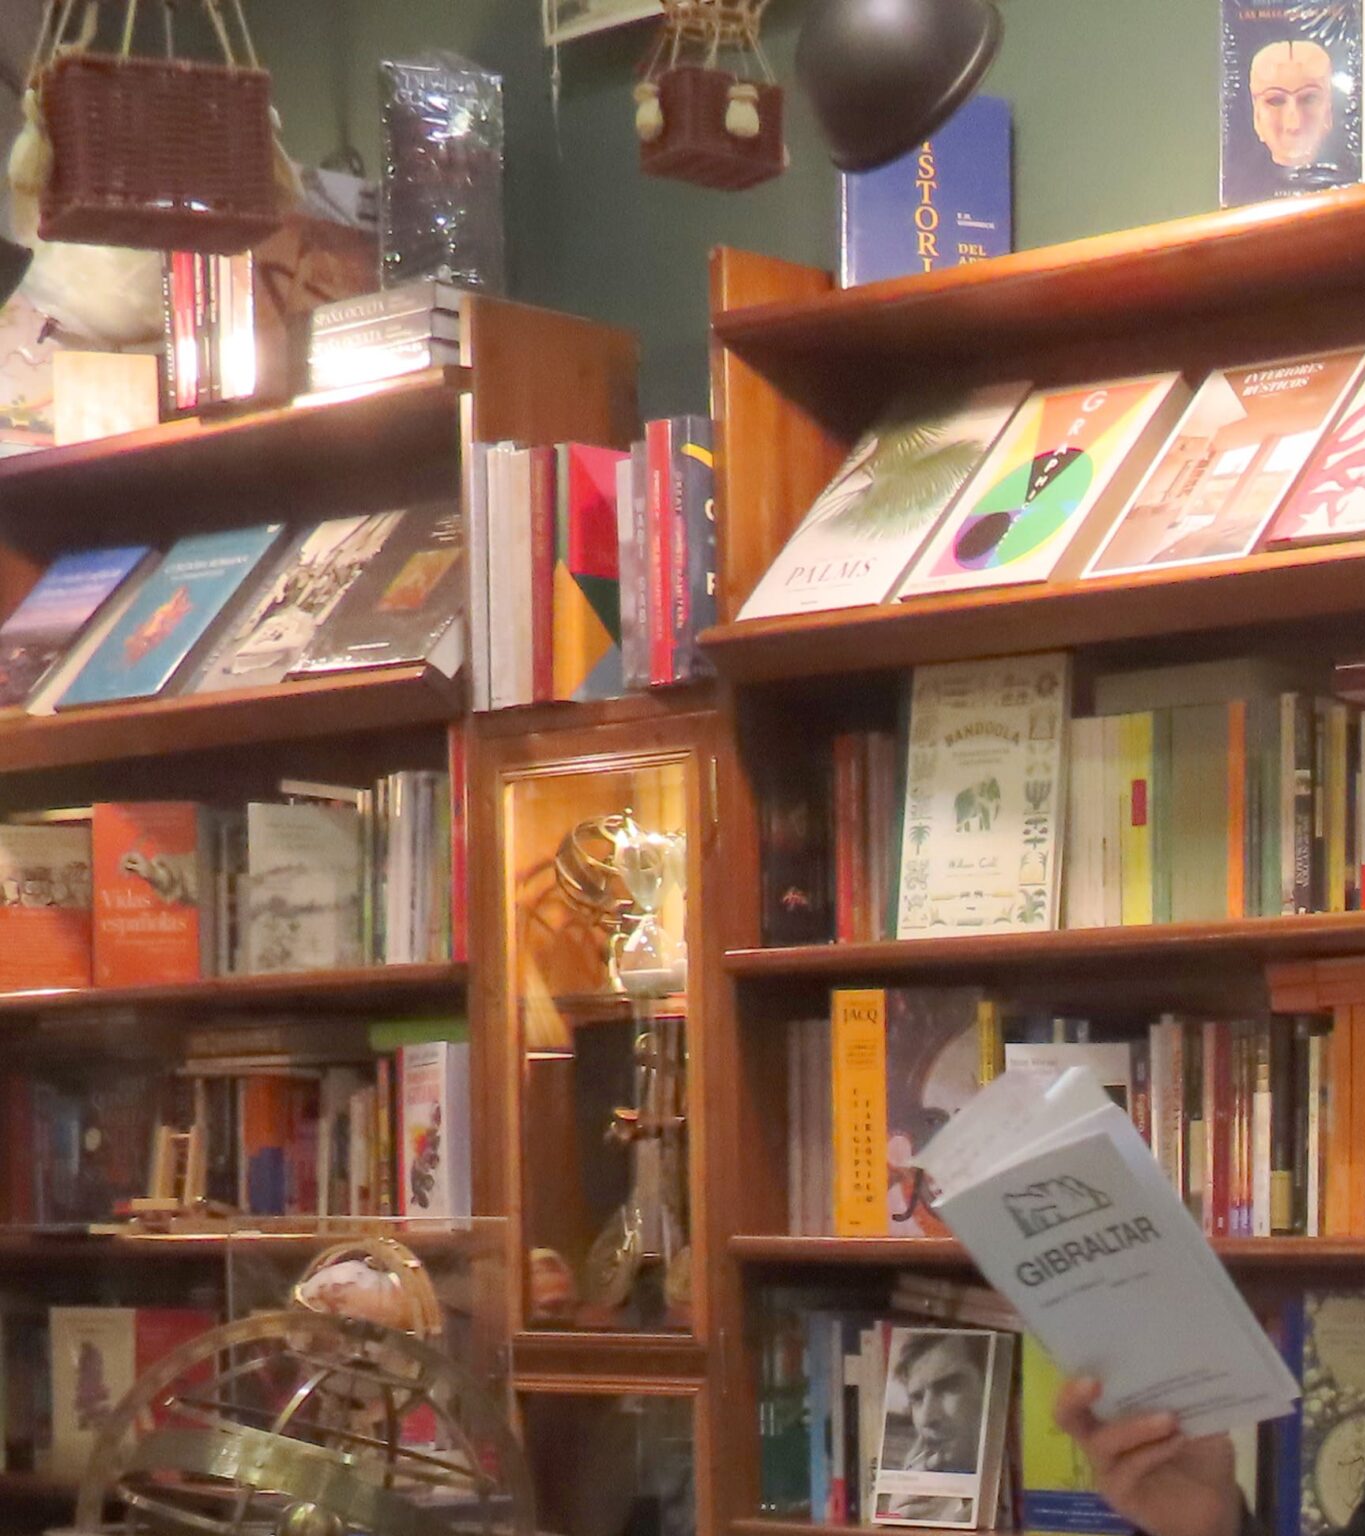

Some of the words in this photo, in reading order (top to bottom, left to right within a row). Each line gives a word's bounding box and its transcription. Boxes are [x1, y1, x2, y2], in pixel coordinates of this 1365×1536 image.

[785, 557, 877, 587] PALMS
[843, 1008, 878, 1025] JACQ
[1015, 1216, 1163, 1288] GIBRALTAR
